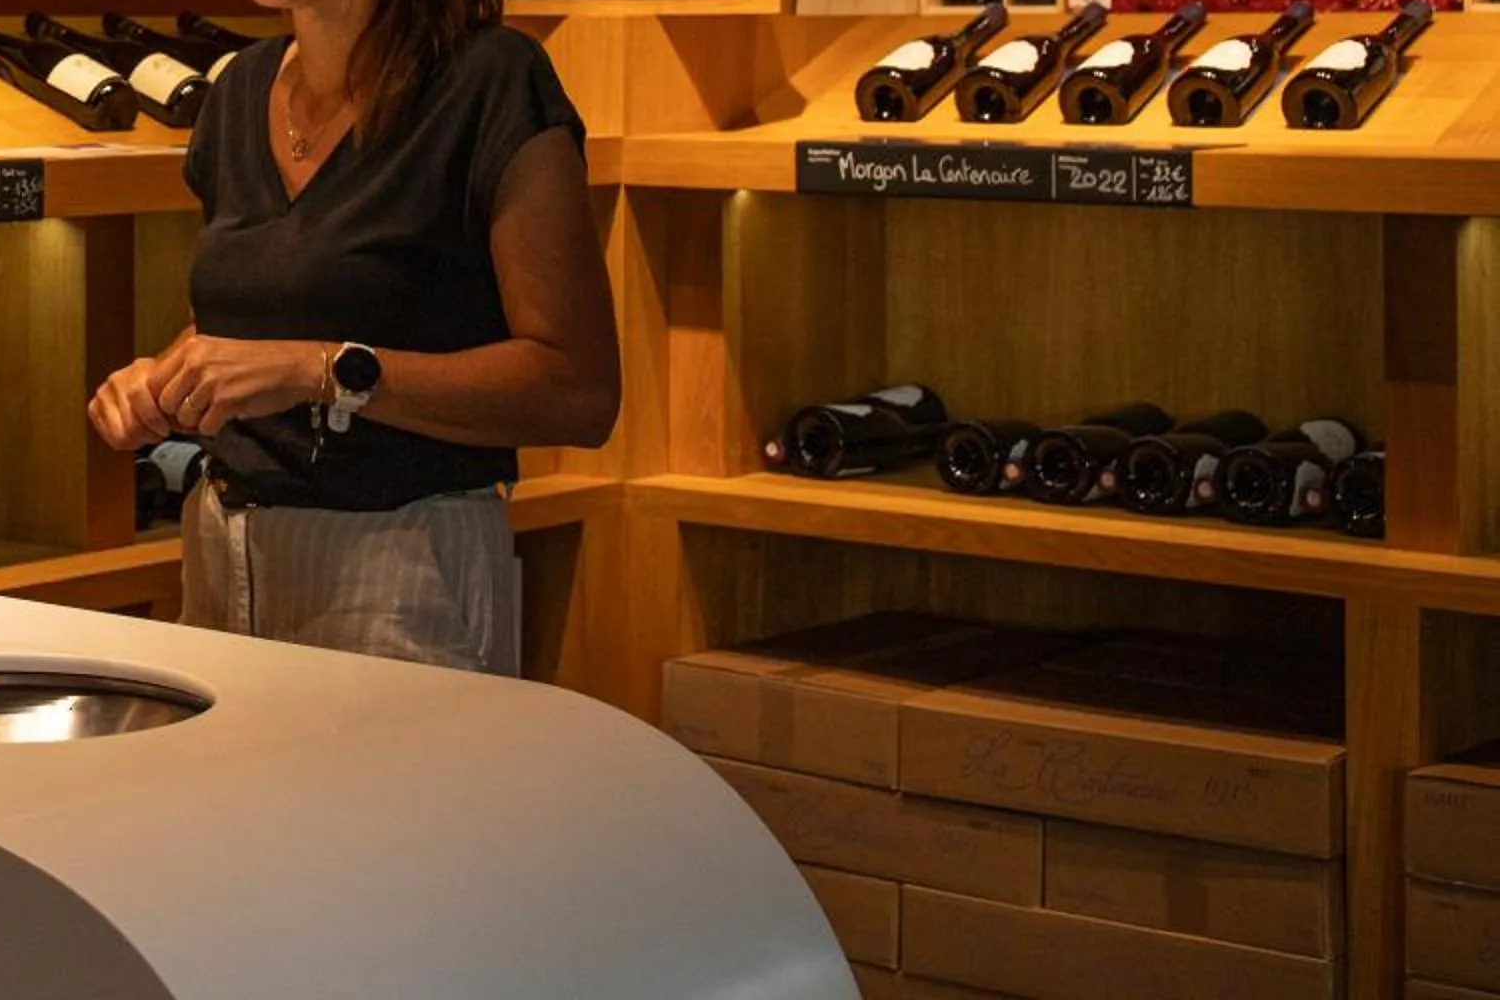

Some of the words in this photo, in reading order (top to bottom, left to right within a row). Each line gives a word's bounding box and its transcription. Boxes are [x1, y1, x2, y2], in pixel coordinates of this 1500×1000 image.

[839, 151, 907, 190] Morgon
[912, 153, 938, 183] La
[938, 153, 1034, 186] Centenaire
[1068, 164, 1128, 195] 2022
